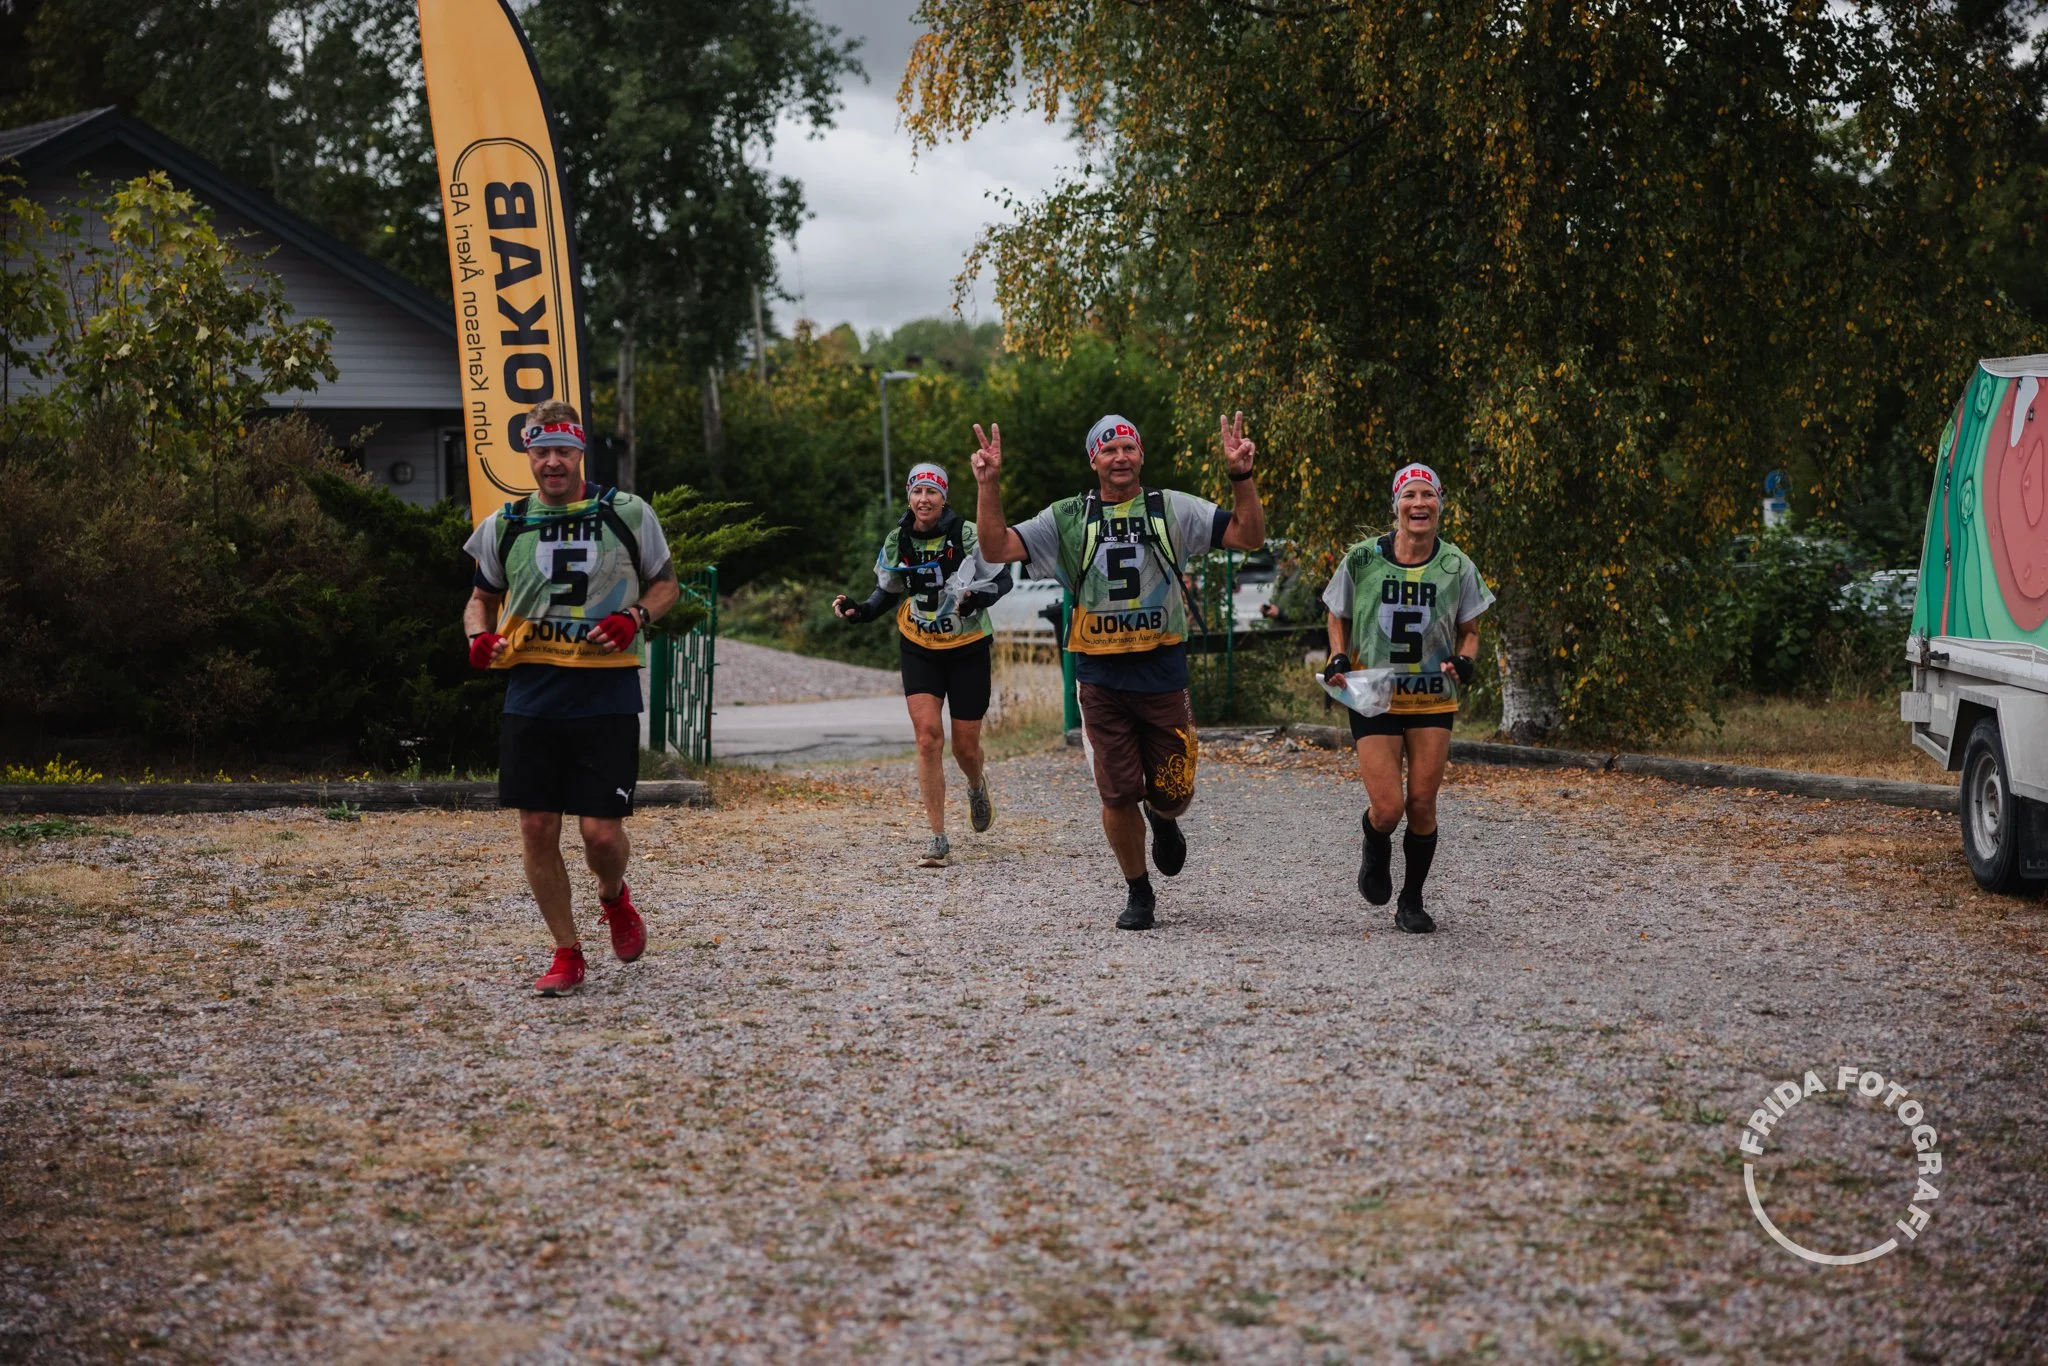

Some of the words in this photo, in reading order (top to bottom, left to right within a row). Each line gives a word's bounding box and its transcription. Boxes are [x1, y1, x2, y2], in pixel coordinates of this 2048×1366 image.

[549, 548, 588, 606] 5
[1106, 546, 1140, 602] 5
[1381, 574, 1437, 608] ÖAR
[524, 620, 603, 645] JOKA
[1090, 611, 1162, 634] JOKAB
[1390, 611, 1423, 664] 5
[1396, 677, 1443, 695] KAB
